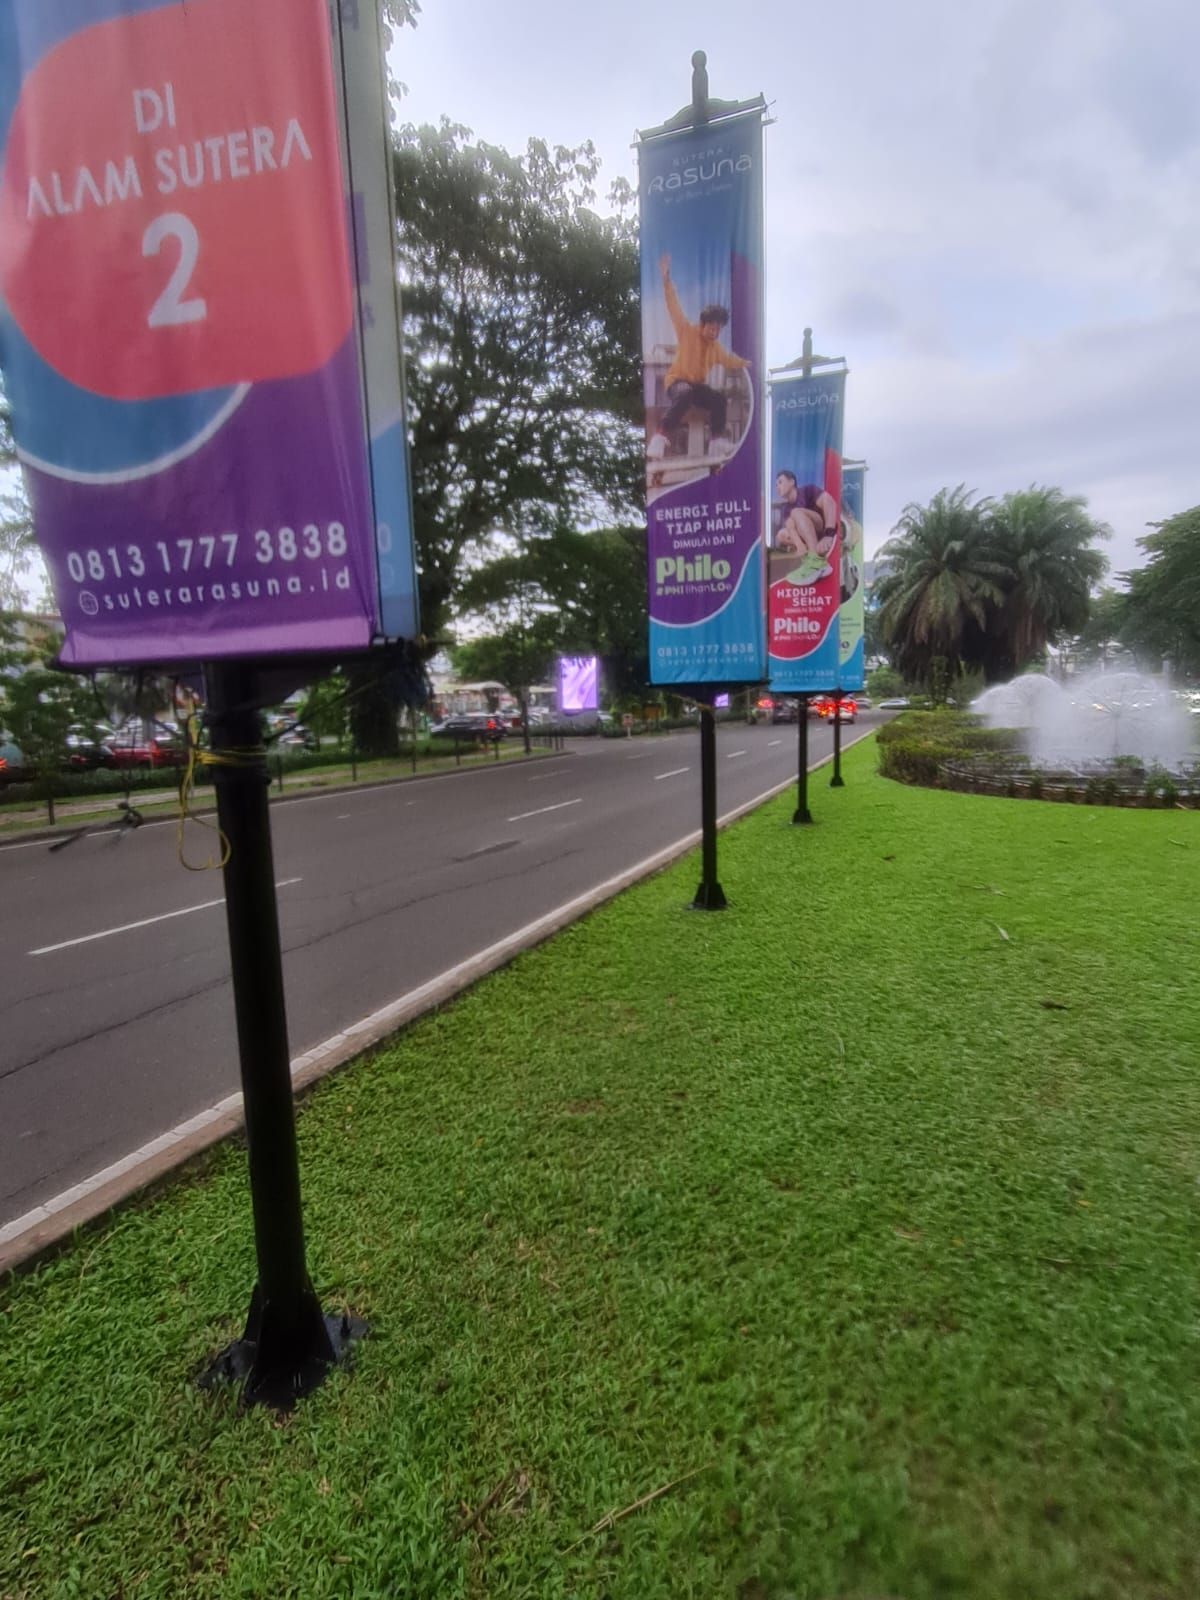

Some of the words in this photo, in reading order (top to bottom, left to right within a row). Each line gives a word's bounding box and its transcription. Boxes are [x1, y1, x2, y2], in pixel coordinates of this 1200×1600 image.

[133, 82, 176, 133] DI
[27, 155, 143, 219] ALAM
[154, 118, 313, 195] SUTERA
[141, 212, 208, 329] 2
[656, 505, 709, 521] ENERGI
[715, 500, 751, 515] FULL
[666, 522, 702, 536] TIAP
[706, 516, 742, 532] HARI
[67, 545, 145, 583] 0813
[157, 533, 239, 574] 1777
[254, 521, 348, 564] 3838
[673, 537, 711, 550] DIMULAI
[712, 535, 735, 546] DARI
[656, 553, 731, 585] Philo
[776, 587, 816, 599] HIDUP
[792, 596, 832, 607] SEHAT
[774, 616, 821, 635] Philo
